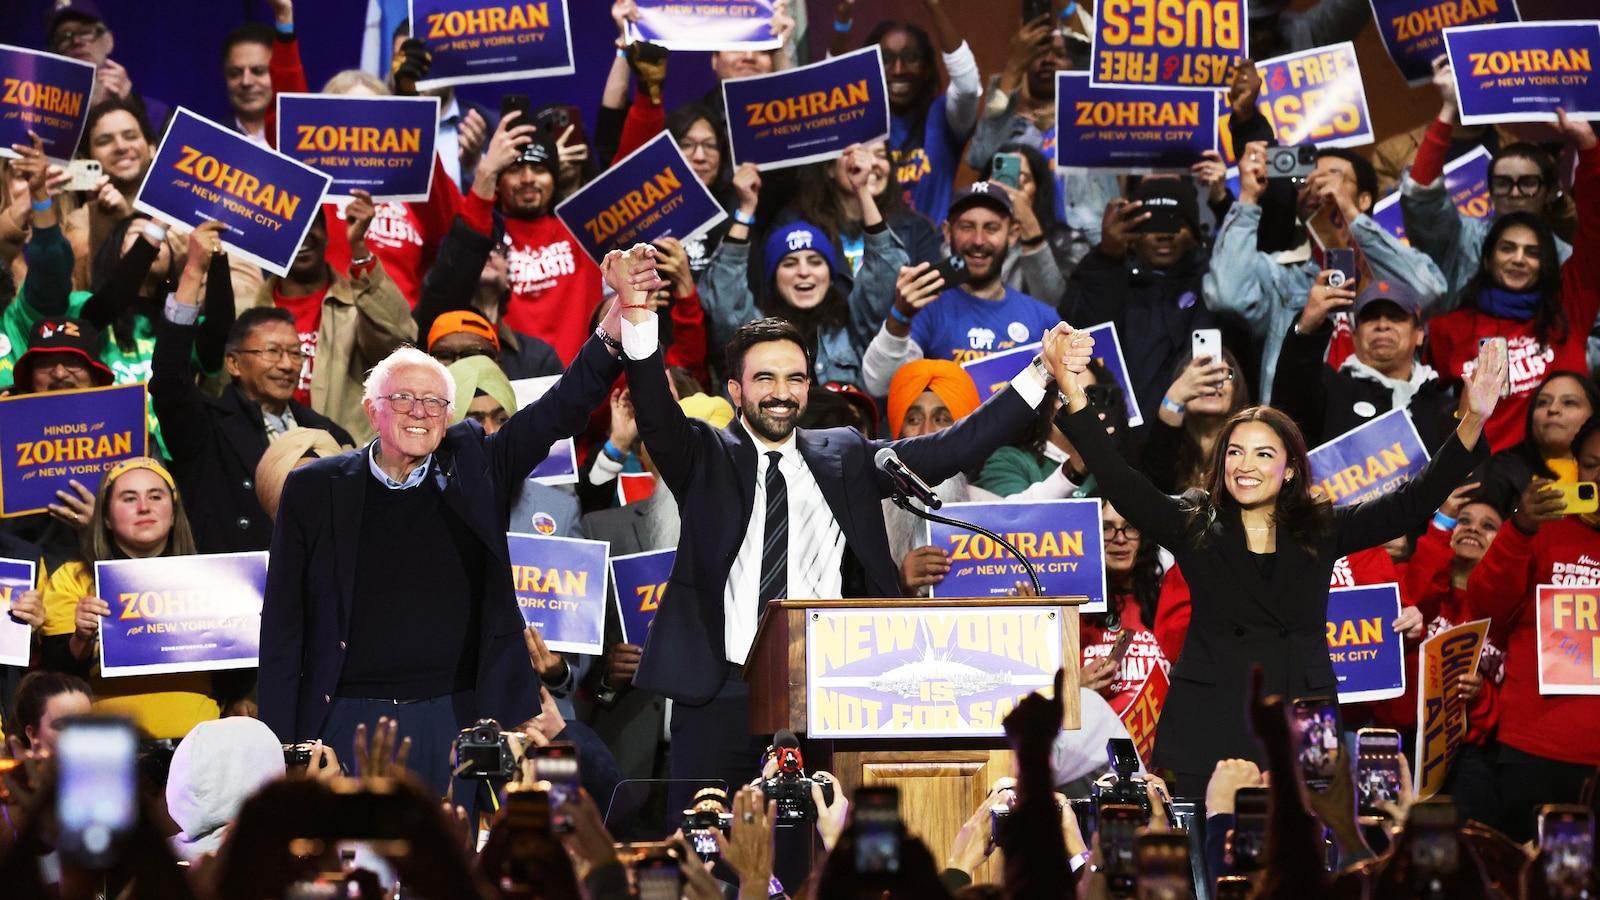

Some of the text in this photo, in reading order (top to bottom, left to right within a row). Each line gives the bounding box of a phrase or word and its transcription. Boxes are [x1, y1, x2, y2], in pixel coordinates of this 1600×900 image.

[427, 2, 550, 39] ZOHRAN
[729, 5, 757, 16] CITY
[1102, 0, 1240, 49] BUSES
[1392, 0, 1500, 42] ZOHRAN
[452, 39, 481, 50] NEW
[483, 35, 516, 48] YORK
[517, 32, 545, 44] CITY
[1416, 35, 1439, 50] NEW
[1098, 51, 1159, 83] FREE
[1287, 51, 1348, 88] FREE
[1468, 48, 1592, 76] ZOHRAN
[1497, 77, 1526, 87] NEW
[1528, 76, 1559, 86] YORK
[1561, 75, 1588, 86] CITY
[3, 77, 83, 118] ZOHRAN
[745, 79, 870, 127] ZOHRAN
[20, 112, 41, 123] NEW
[43, 115, 59, 127] YORK
[773, 122, 801, 136] NEW
[805, 116, 837, 133] YORK
[839, 108, 866, 124] CITY
[1075, 101, 1199, 127] ZOHRAN
[296, 125, 422, 153] ZOHRAN
[1099, 131, 1127, 140] NEW
[1130, 131, 1162, 140] YORK
[1165, 131, 1193, 141] CITY
[320, 156, 349, 166] NEW
[353, 157, 385, 167] YORK
[388, 157, 413, 168] CITY
[173, 145, 301, 221] ZOHRAN
[191, 184, 221, 204] NEW
[222, 197, 254, 219] YORK
[255, 213, 283, 231] CITY
[584, 166, 682, 245] ZOHRAN
[616, 229, 637, 246] NEW
[636, 211, 663, 231] YORK
[661, 194, 684, 215] CITY
[969, 335, 994, 350] UFT
[44, 423, 88, 435] HINDUS
[16, 431, 132, 467] ZOHRAN
[39, 467, 67, 478] NEW
[69, 464, 101, 475] YORK
[1310, 442, 1410, 502] HRAN
[949, 531, 1085, 560] ZOHRAN
[511, 564, 588, 597] RAN
[956, 567, 974, 578] FOR
[976, 565, 1009, 575] NEW
[1048, 562, 1079, 573] CITY
[548, 598, 579, 611] CITY
[126, 617, 248, 636] FOR NEW YORK CITY
[1326, 617, 1384, 647] RAN
[815, 614, 1054, 677] NEW YORK
[1348, 649, 1378, 661] CITY
[1559, 635, 1584, 665] THE
[1428, 653, 1439, 689] FOR
[920, 681, 954, 702] IS
[817, 687, 883, 730] NOT
[892, 704, 959, 730] FOR
[1422, 697, 1444, 788] ALL
